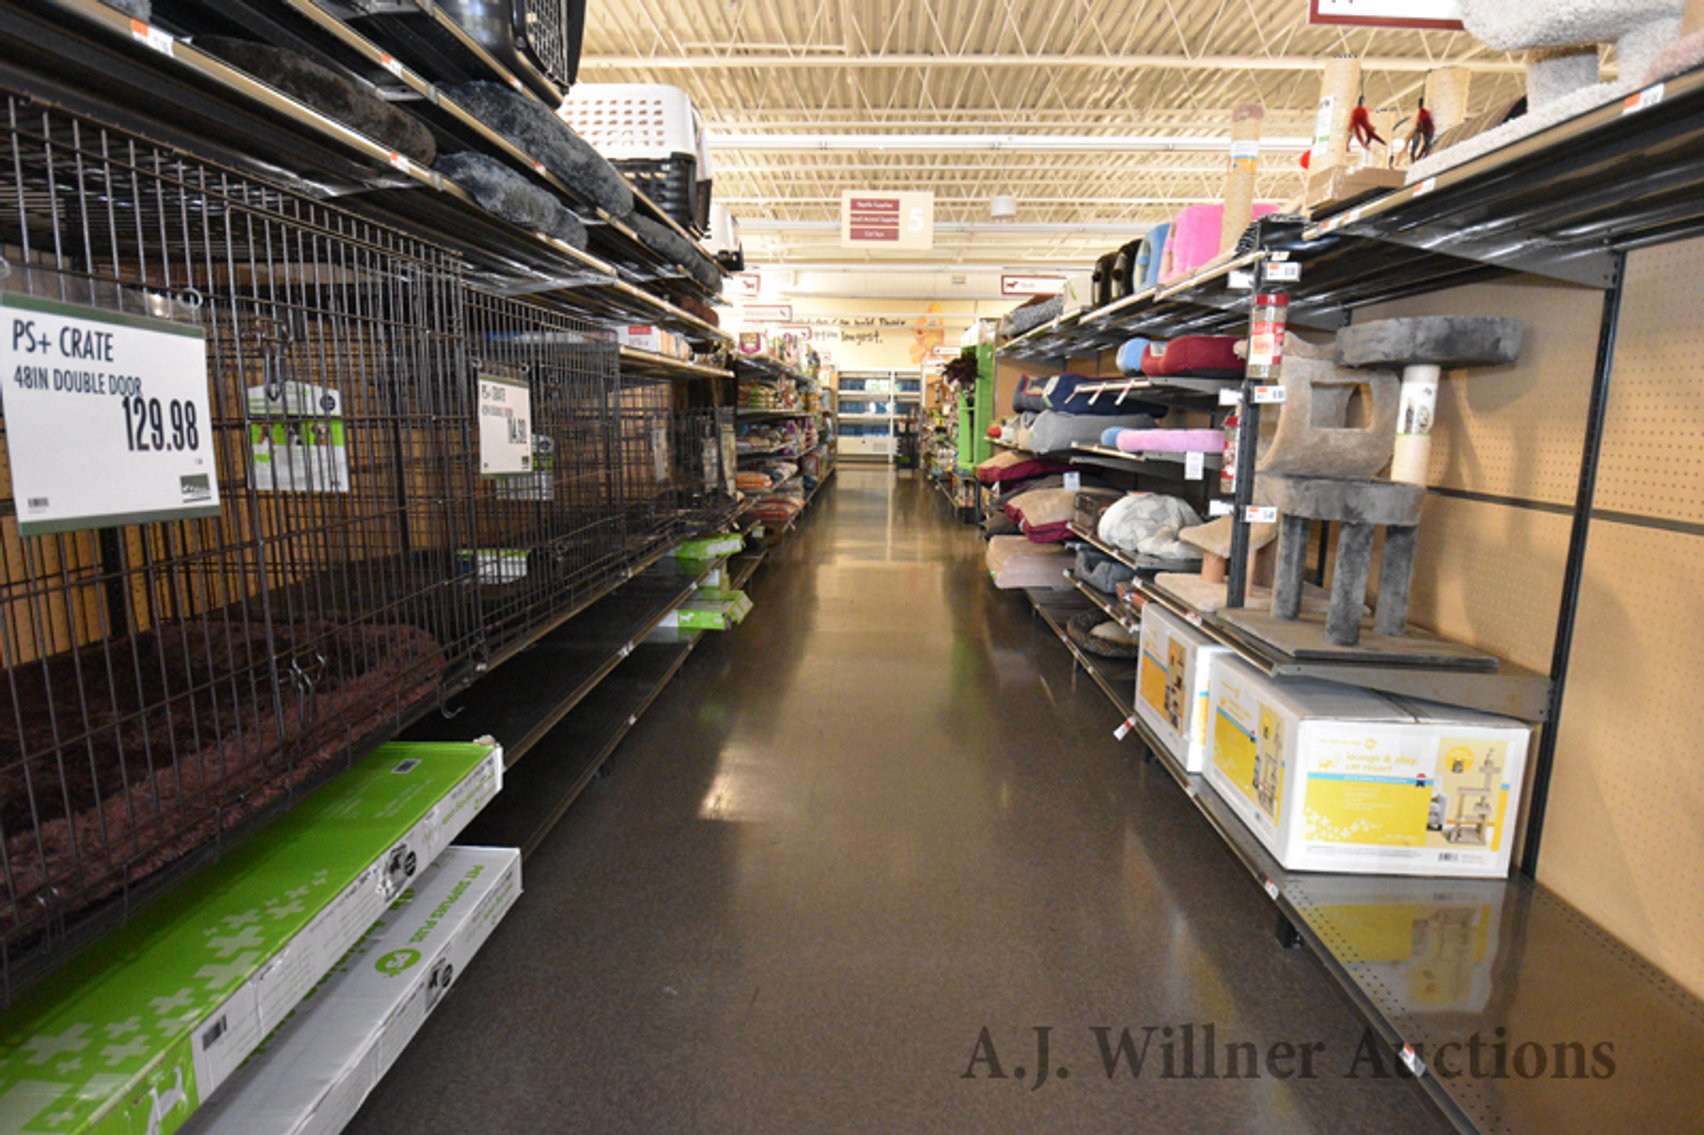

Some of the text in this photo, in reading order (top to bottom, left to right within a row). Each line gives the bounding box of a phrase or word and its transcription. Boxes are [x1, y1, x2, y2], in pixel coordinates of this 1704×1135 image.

[907, 208, 925, 232] 5
[12, 319, 114, 362] PS+ CRATE
[14, 364, 142, 397] 48IN DOUBLE DOOR
[122, 396, 199, 452] 129.98
